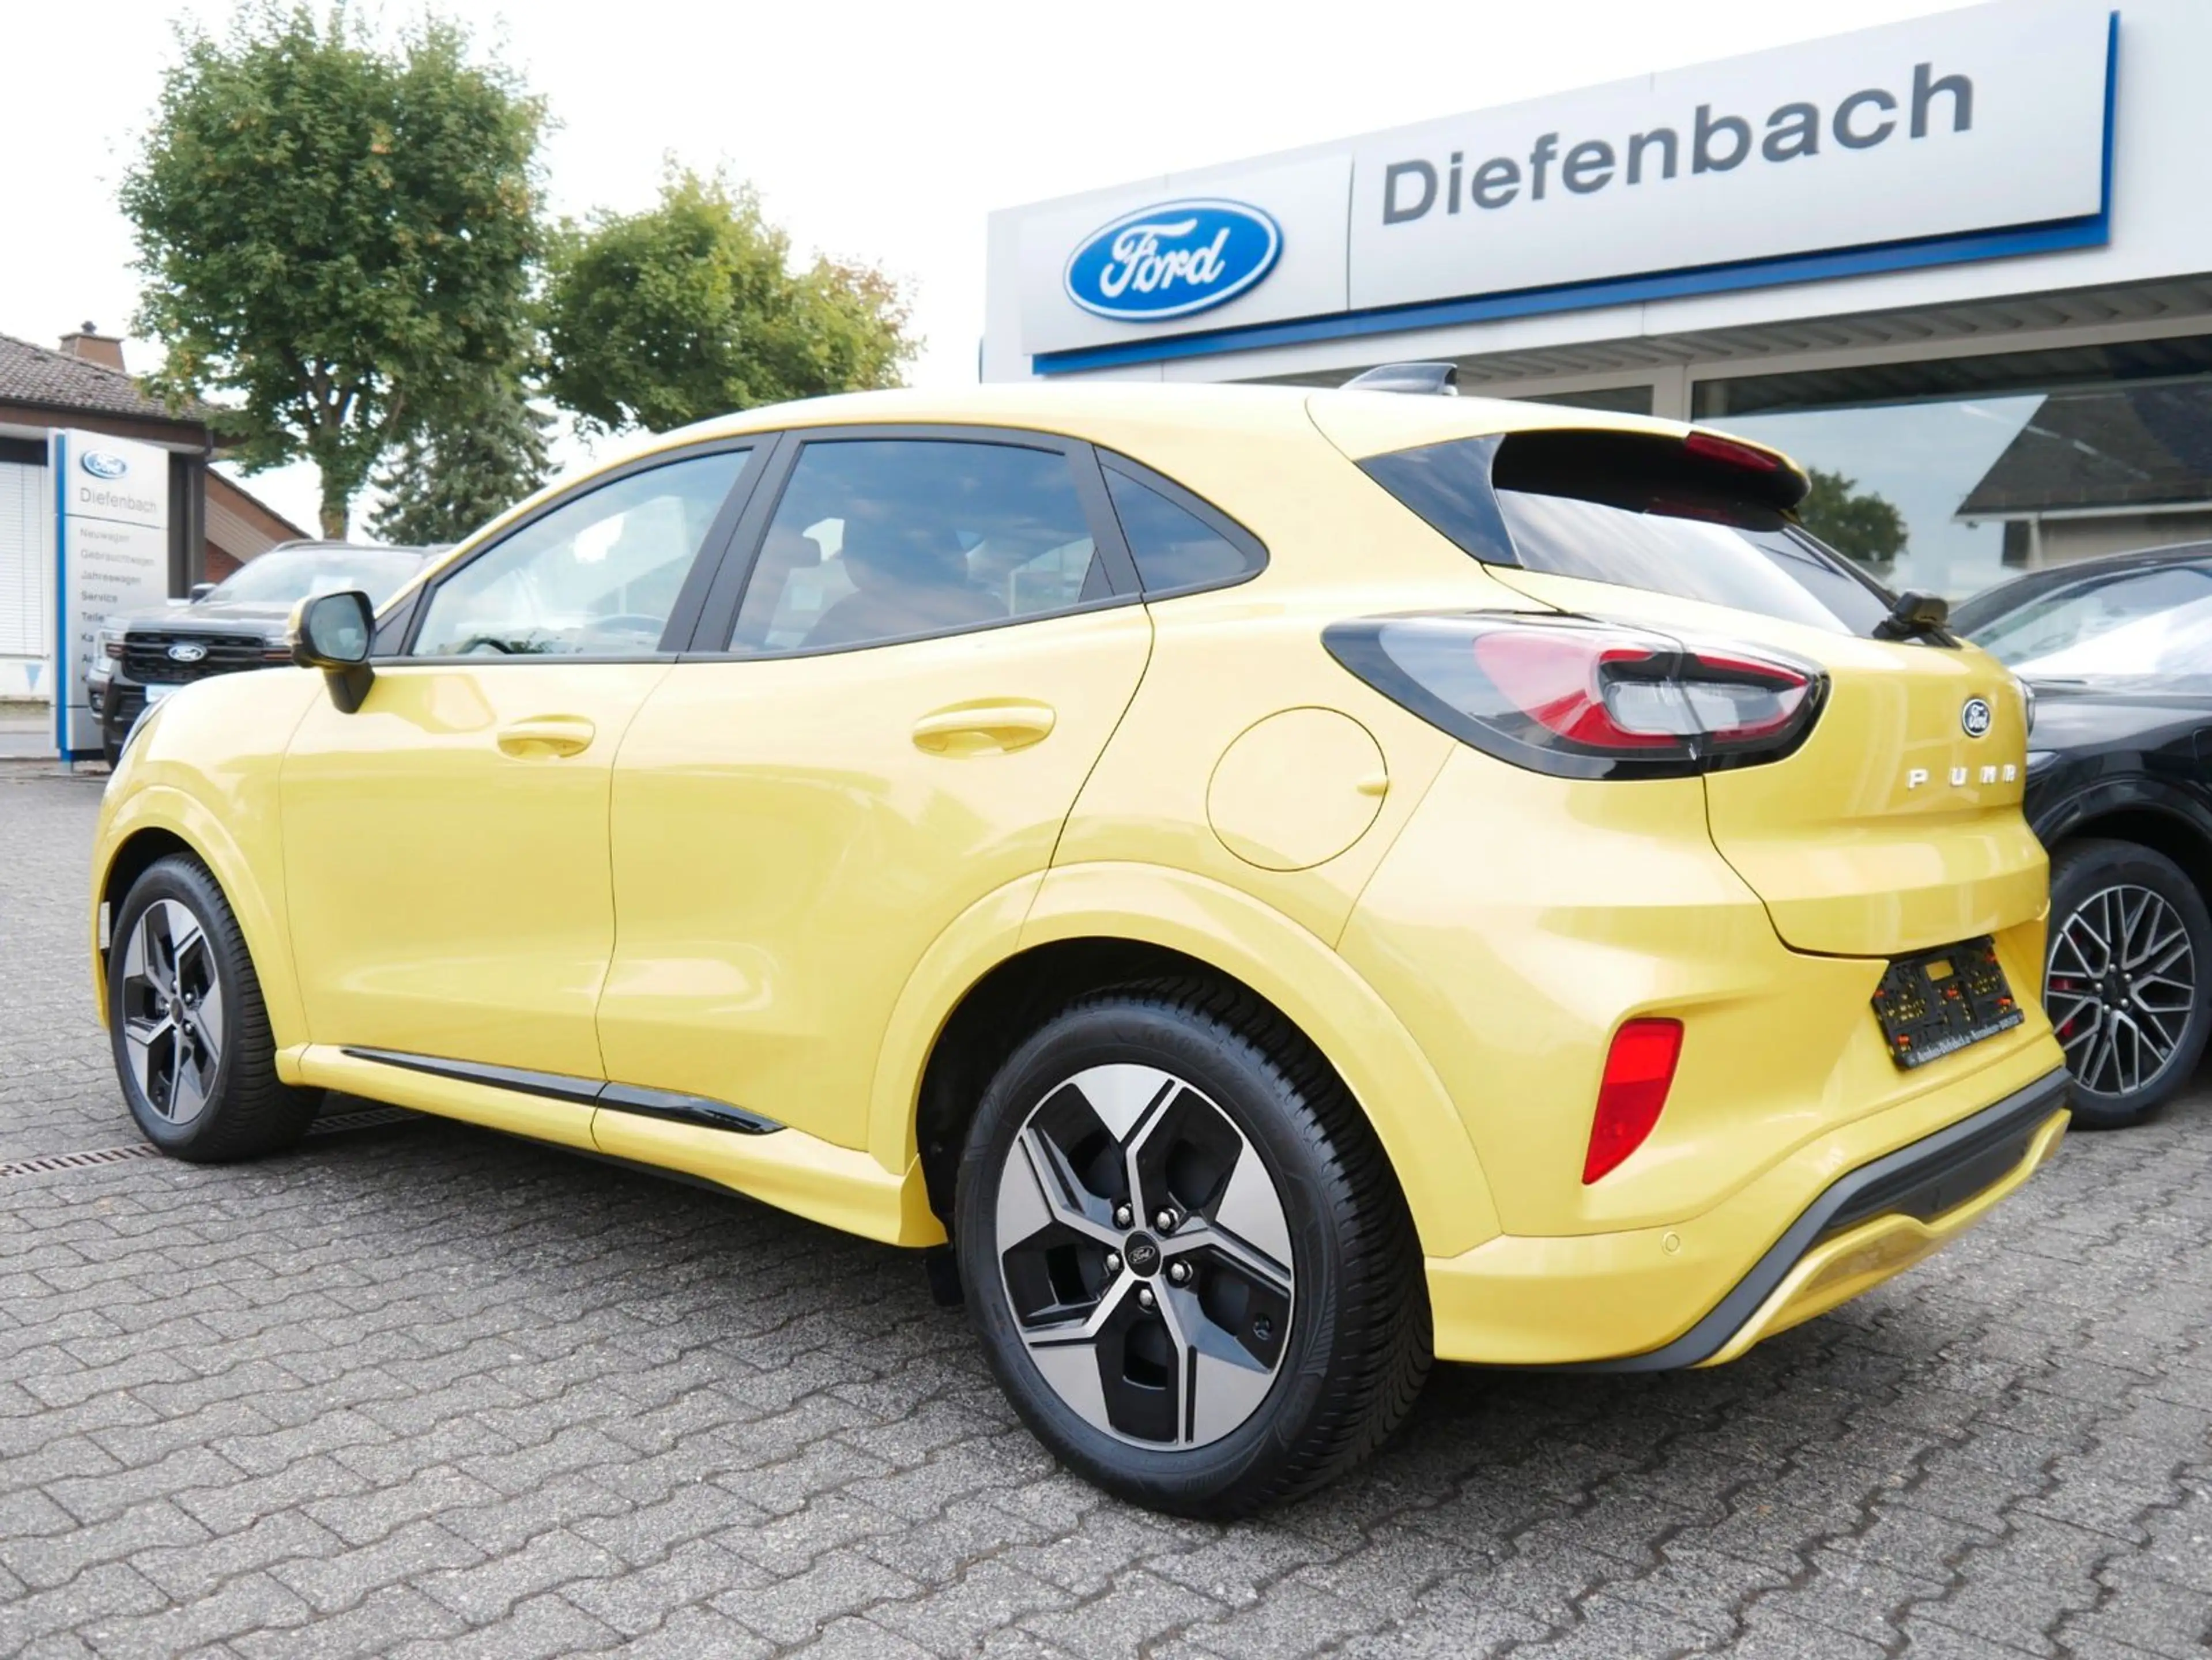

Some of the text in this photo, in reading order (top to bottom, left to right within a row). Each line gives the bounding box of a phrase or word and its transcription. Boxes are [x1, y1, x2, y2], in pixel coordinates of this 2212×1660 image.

[1382, 61, 1974, 226] Diefenbach
[1099, 217, 1231, 299] Ford
[80, 487, 156, 514] Diefenbach
[80, 528, 130, 545] Neuwagen
[81, 548, 154, 567] Gebrauchtwagen
[81, 570, 142, 586] Jahreswagen
[81, 590, 118, 603] Service
[1968, 703, 1988, 729] Ford
[1907, 764, 2017, 790] PUMA
